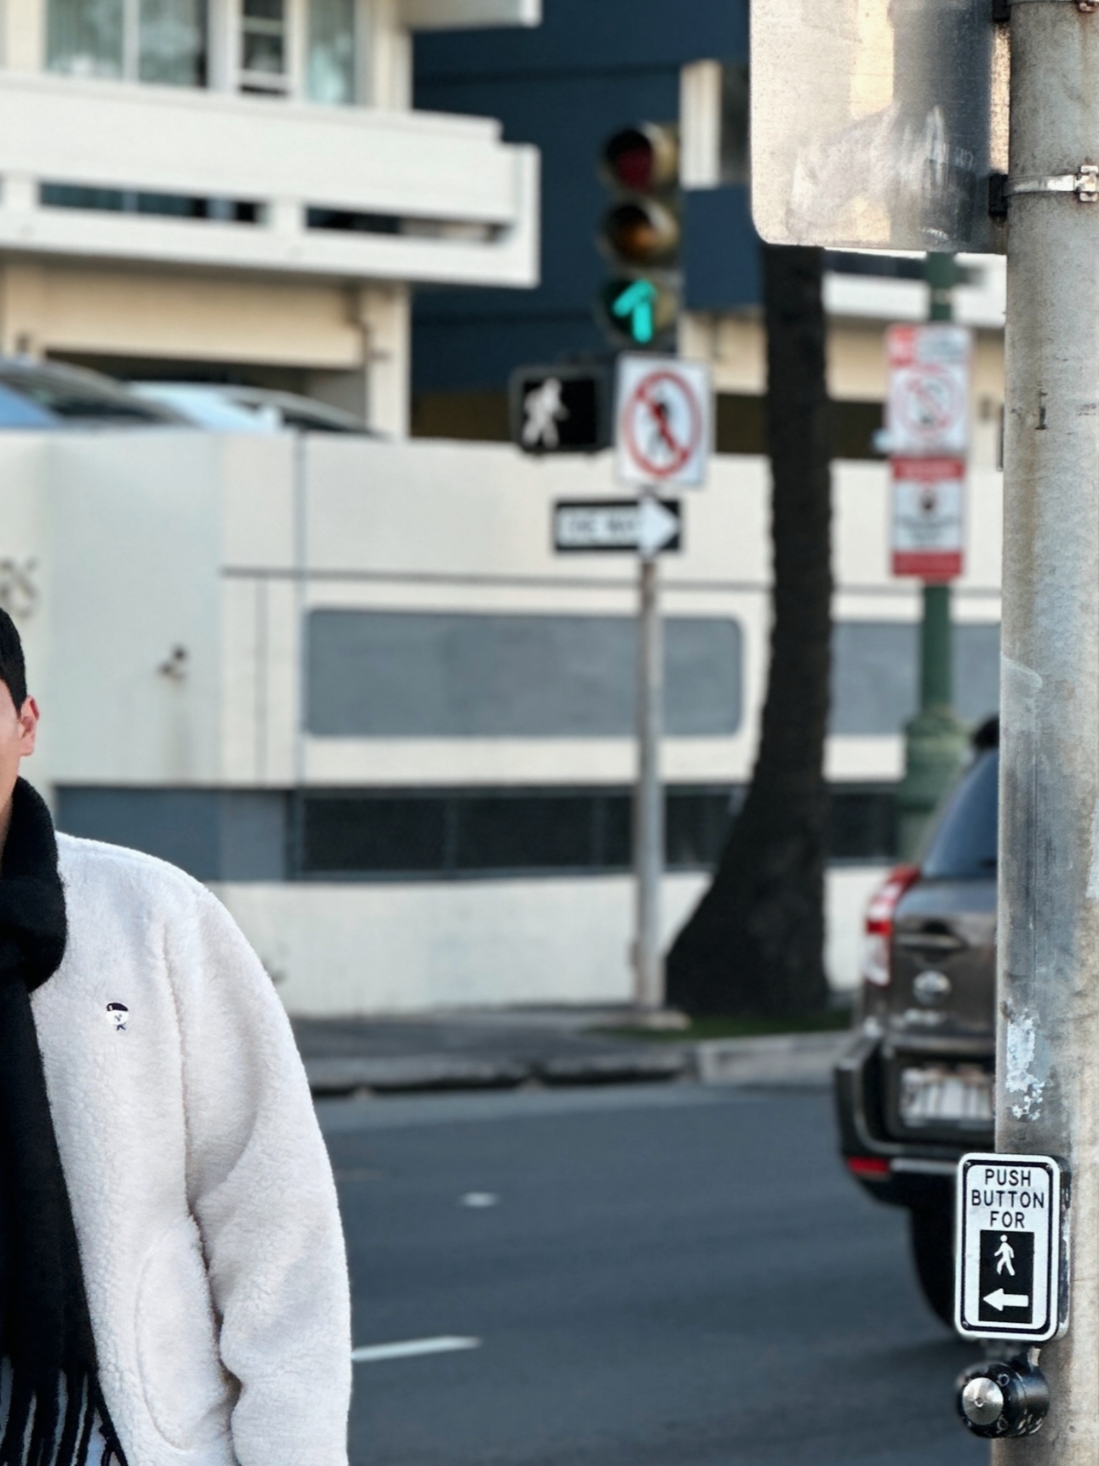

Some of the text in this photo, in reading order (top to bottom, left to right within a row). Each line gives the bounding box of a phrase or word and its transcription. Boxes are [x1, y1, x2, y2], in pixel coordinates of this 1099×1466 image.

[985, 1168, 1031, 1186] PUSH
[971, 1189, 1044, 1208] BUTTON
[990, 1211, 1025, 1228] FOR
